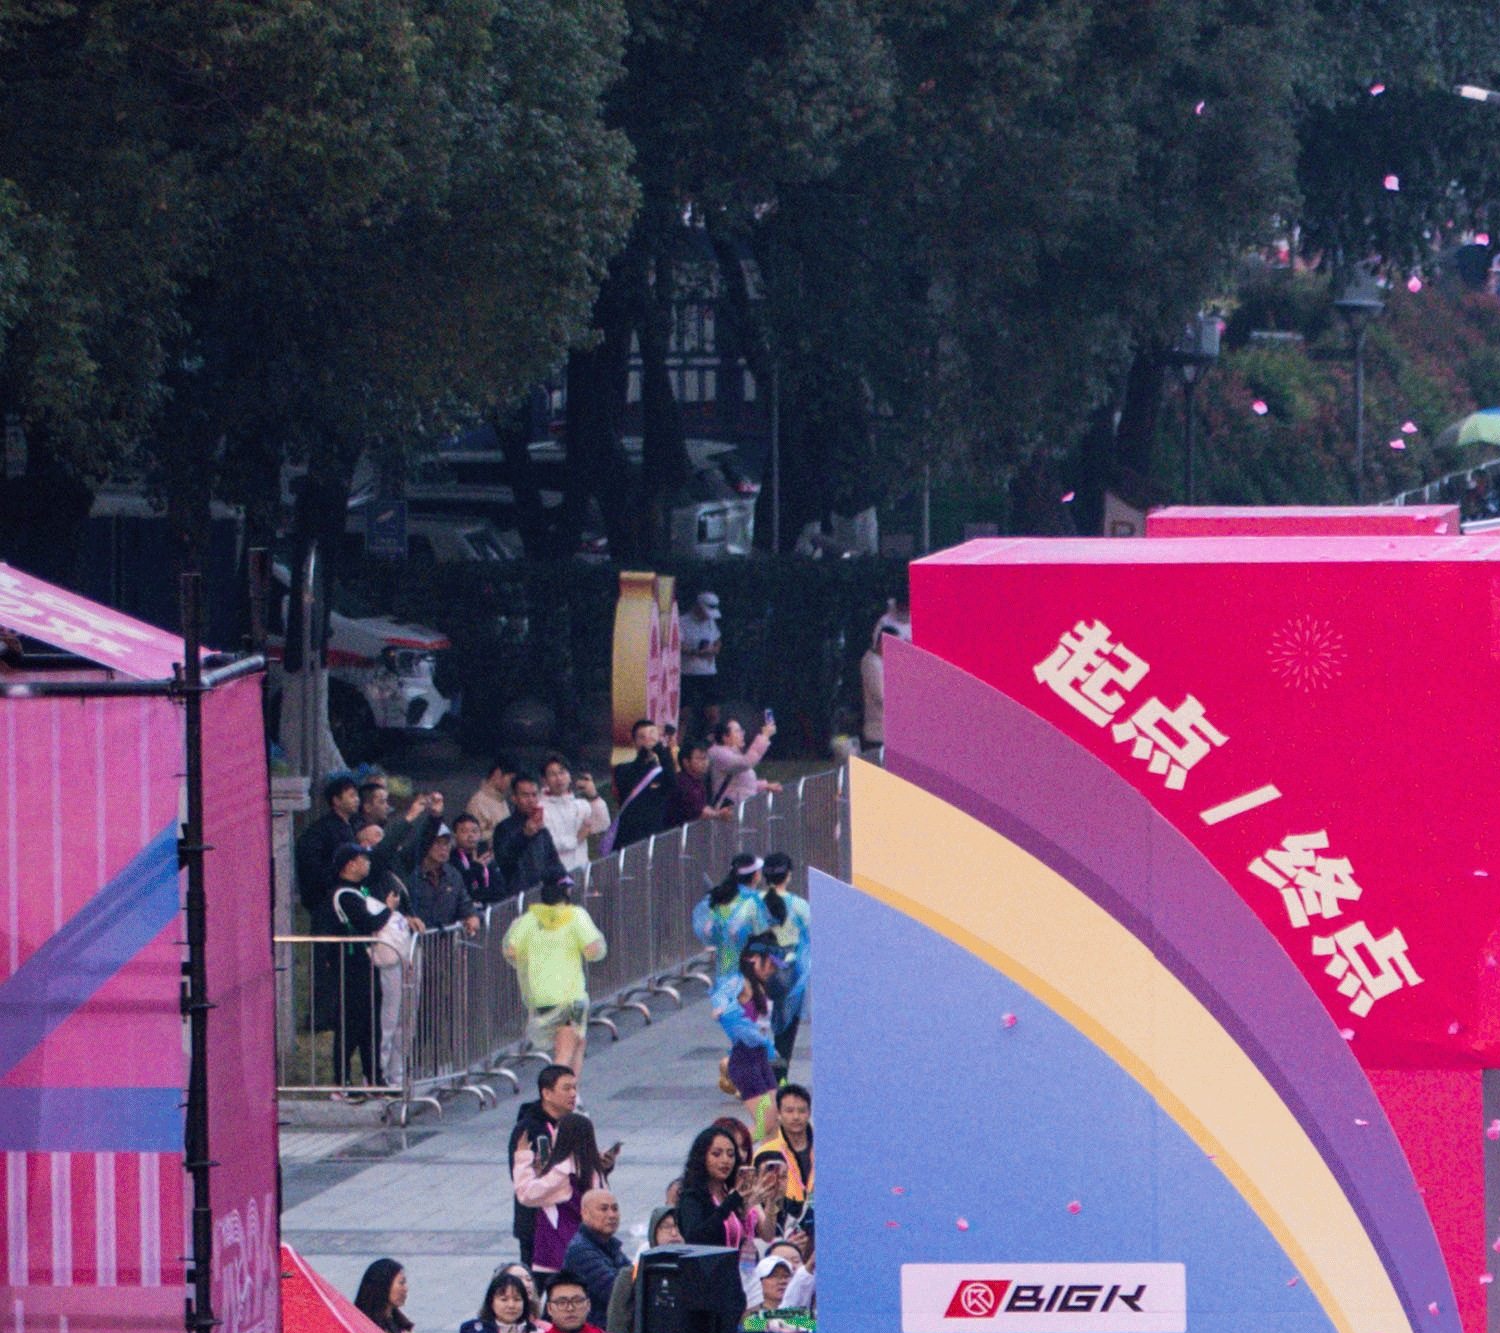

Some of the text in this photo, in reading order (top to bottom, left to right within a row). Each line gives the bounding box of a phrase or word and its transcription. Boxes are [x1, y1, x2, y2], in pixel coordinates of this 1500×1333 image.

[1033, 620, 1228, 790] 起点
[1248, 830, 1423, 1017] 终点
[1004, 1284, 1147, 1313] BIGK
